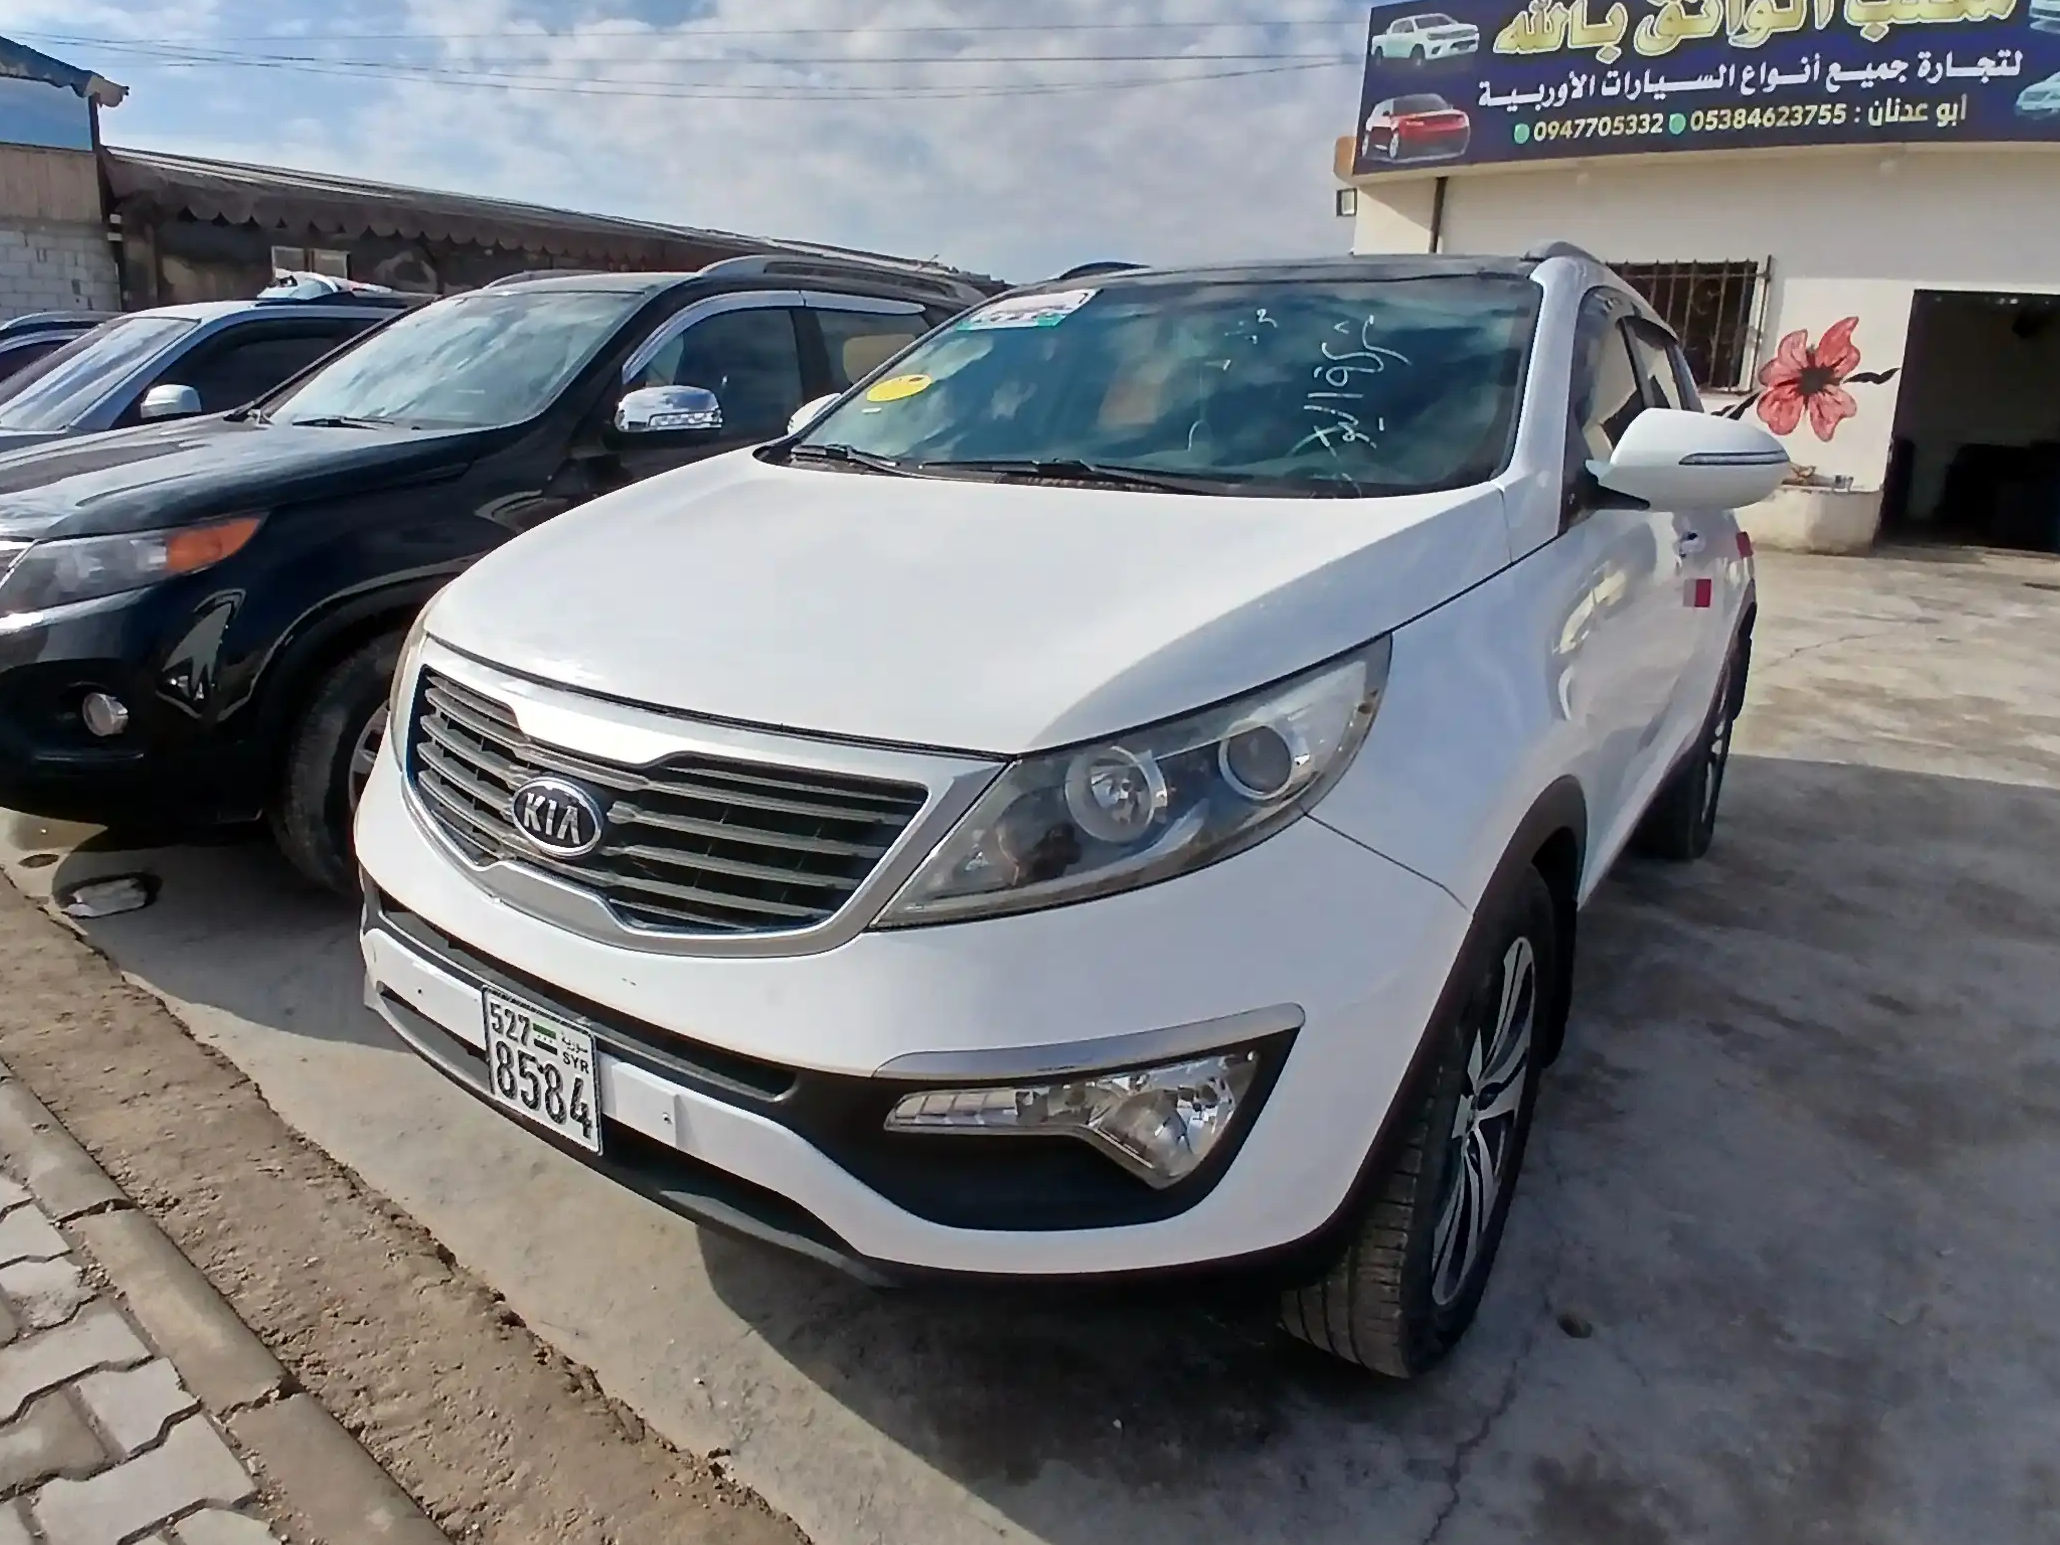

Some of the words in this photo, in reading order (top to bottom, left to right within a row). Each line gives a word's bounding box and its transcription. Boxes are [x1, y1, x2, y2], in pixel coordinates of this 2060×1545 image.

[1601, 62, 1735, 101] السيارات
[1740, 53, 1821, 96] أنواع
[1825, 58, 1909, 93] جميع
[1917, 49, 2024, 84] لتجارة
[1478, 70, 1596, 112] الأوربية
[1533, 112, 1664, 142] 0947705332
[1690, 103, 1847, 132] 05384623755
[1868, 97, 1929, 127] عدنان
[524, 792, 581, 845] KIA
[490, 1002, 531, 1046] 527
[562, 1051, 589, 1074] SYR
[496, 1040, 593, 1139] 8584
